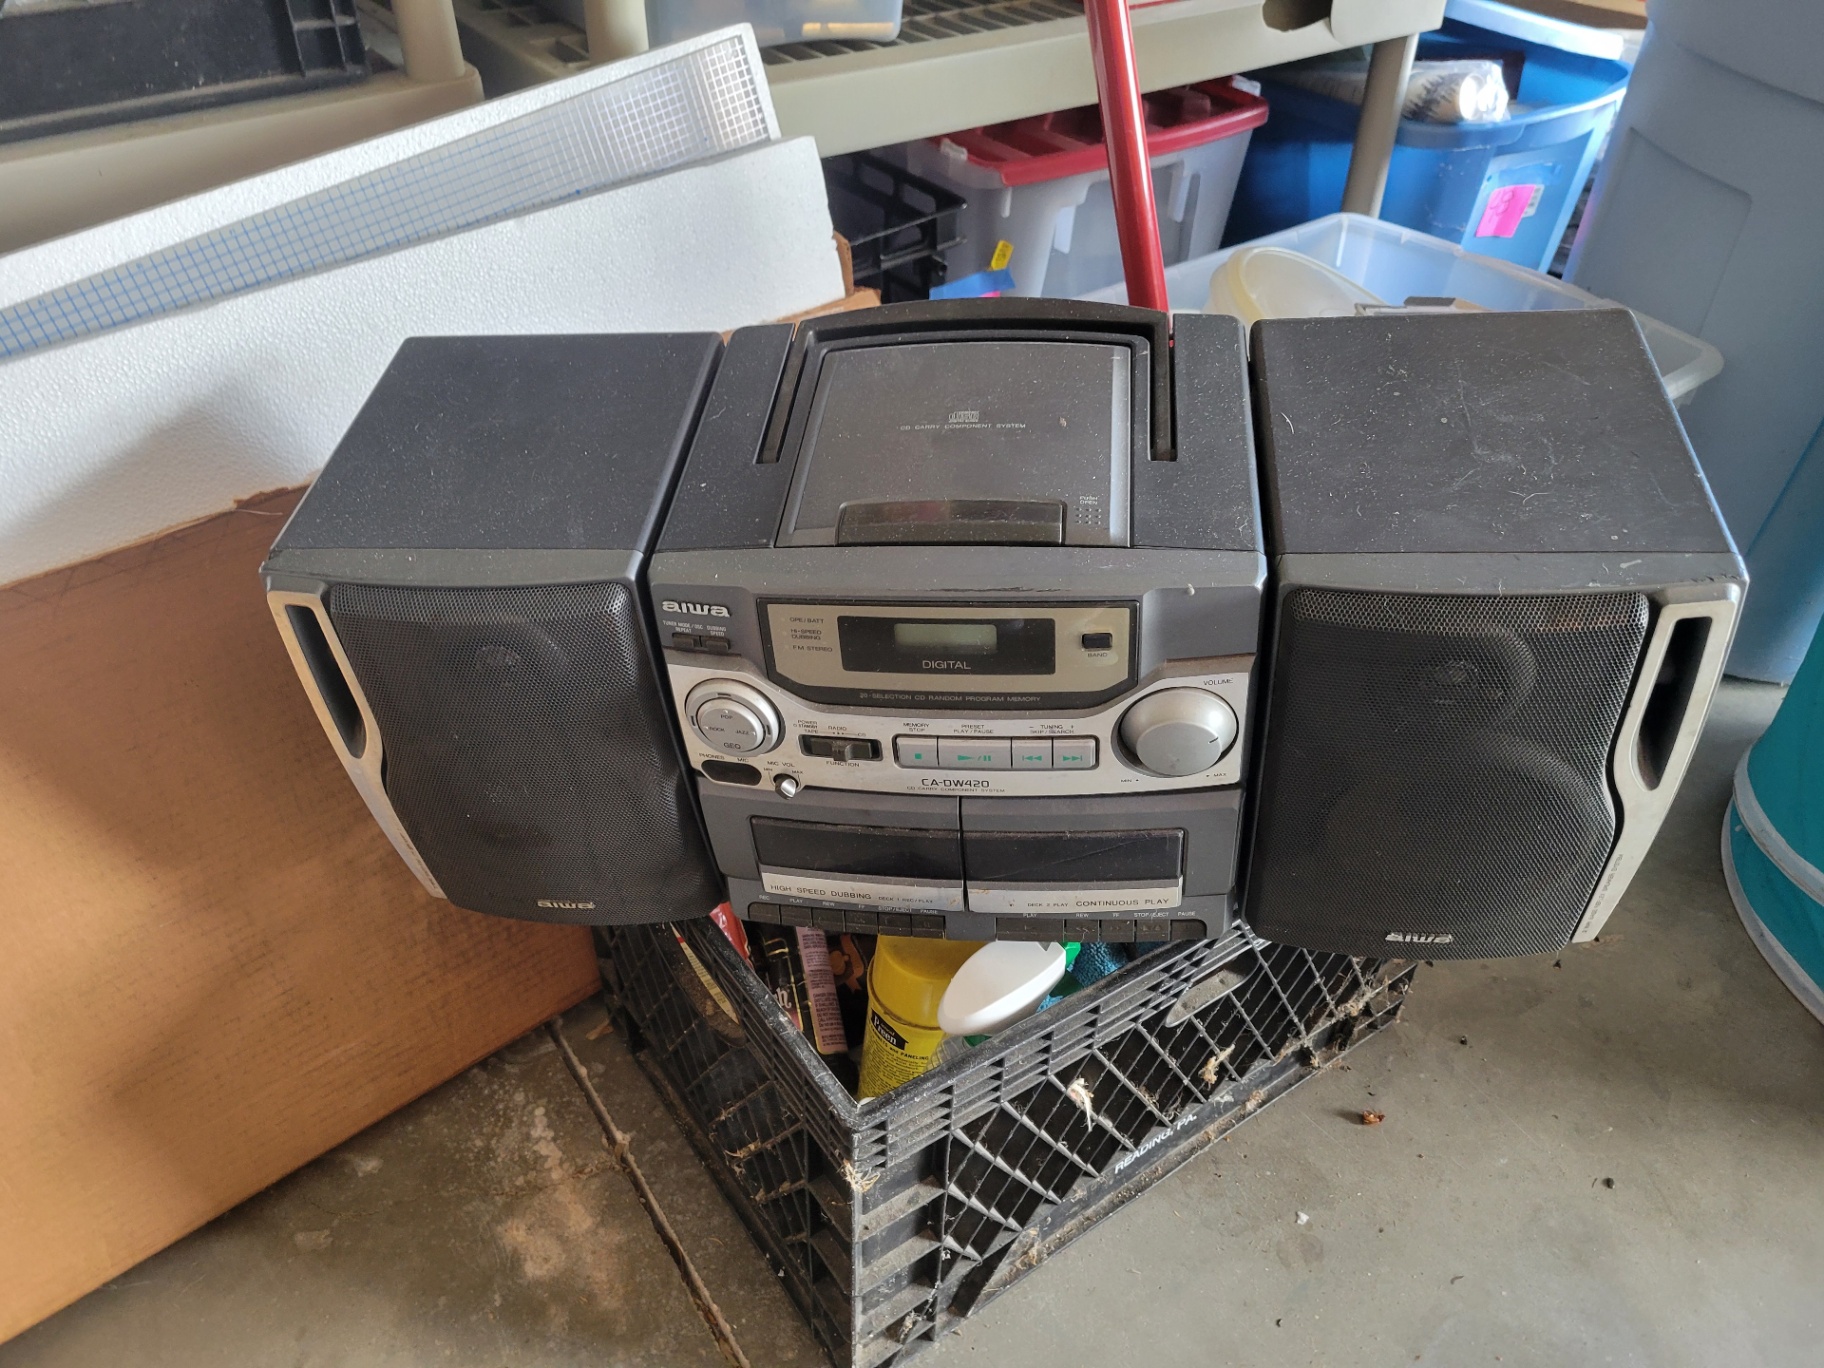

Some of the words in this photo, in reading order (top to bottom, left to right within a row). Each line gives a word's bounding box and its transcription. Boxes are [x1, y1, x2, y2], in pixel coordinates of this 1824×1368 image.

[662, 600, 730, 618] aiwa
[922, 660, 971, 670] DIGITAL
[1203, 678, 1233, 686] VOLUME
[723, 742, 741, 750] GEQ
[699, 753, 725, 761] PHONES
[921, 778, 990, 789] CA-DW420
[770, 884, 792, 892] HIGH
[796, 887, 826, 896] SPEED
[830, 891, 871, 900] DUBBING
[537, 900, 596, 909] aiwa
[1385, 932, 1453, 943] aiwa
[900, 1052, 929, 1060] PANELING
[1114, 1127, 1174, 1175] READING,
[1176, 1113, 1198, 1131] PA.
